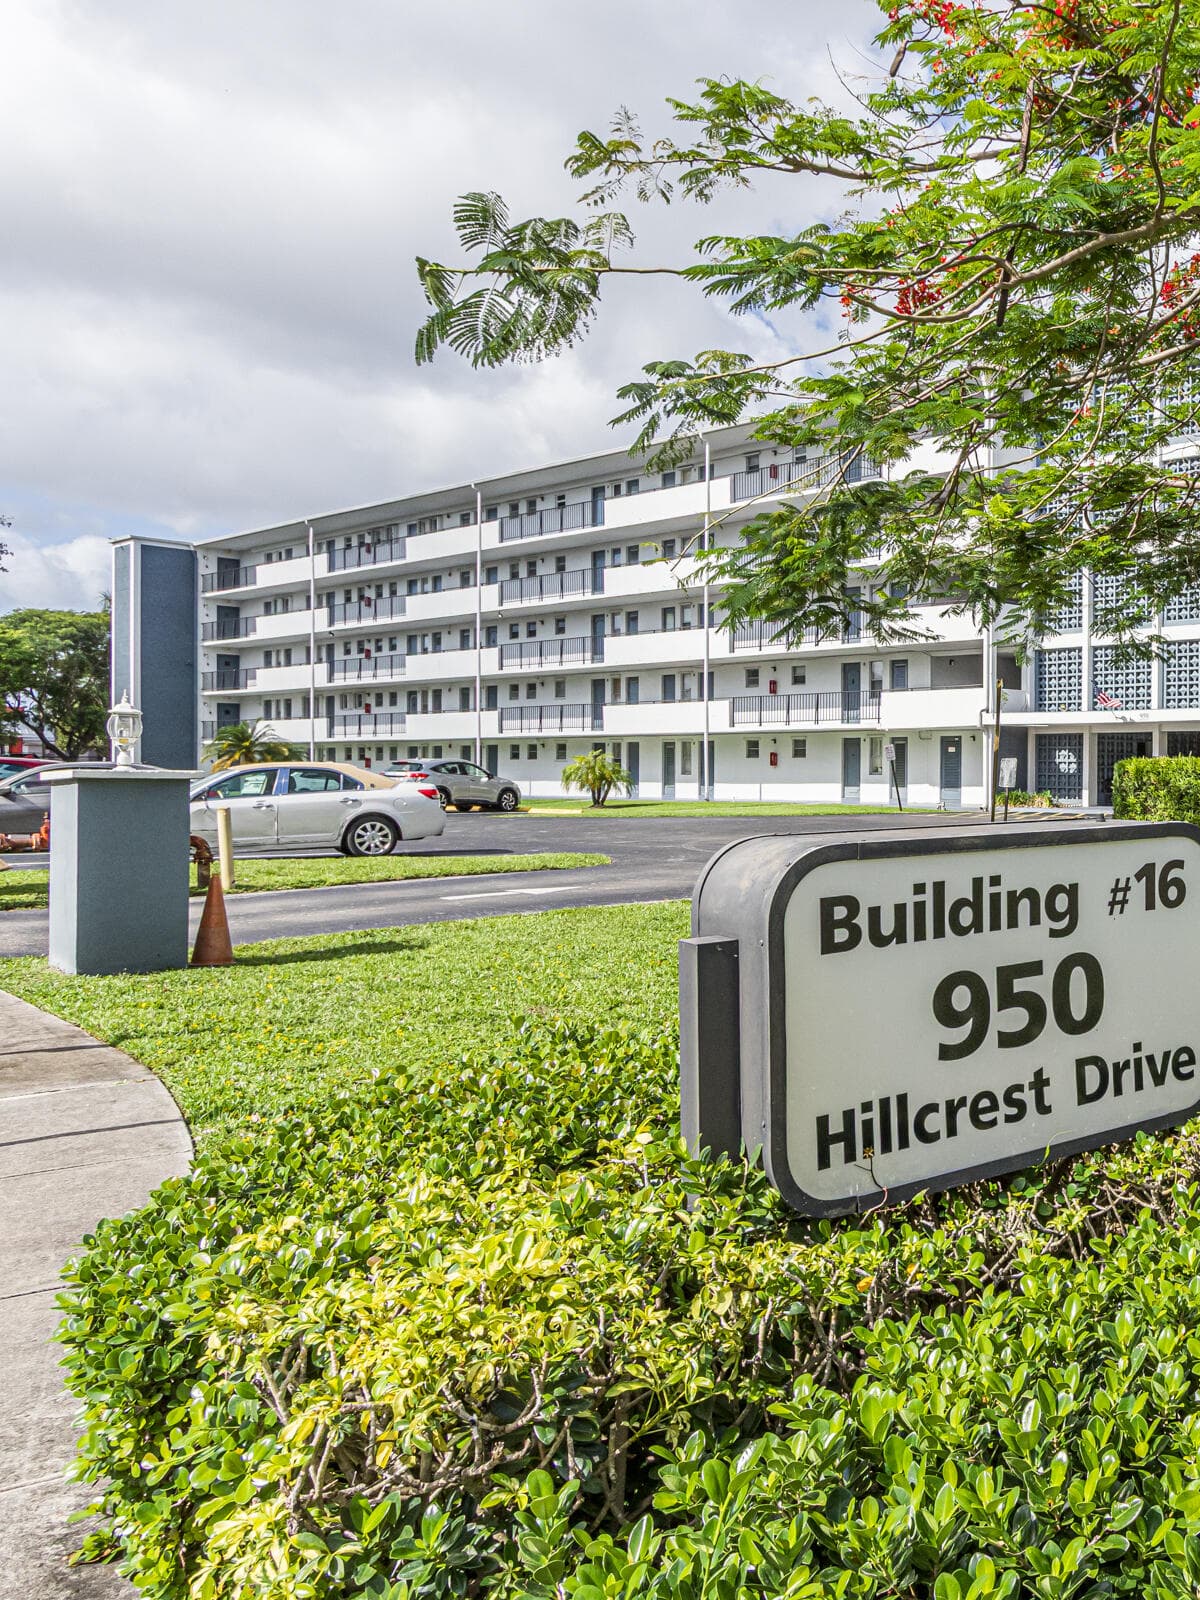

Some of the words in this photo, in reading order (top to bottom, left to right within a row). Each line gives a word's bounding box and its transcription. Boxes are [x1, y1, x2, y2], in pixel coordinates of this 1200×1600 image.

[819, 874, 1079, 955] Building
[1107, 859, 1187, 916] #16
[931, 951, 1105, 1062] 950
[815, 1066, 1053, 1172] Hillcrest
[1074, 1041, 1197, 1106] Drive
